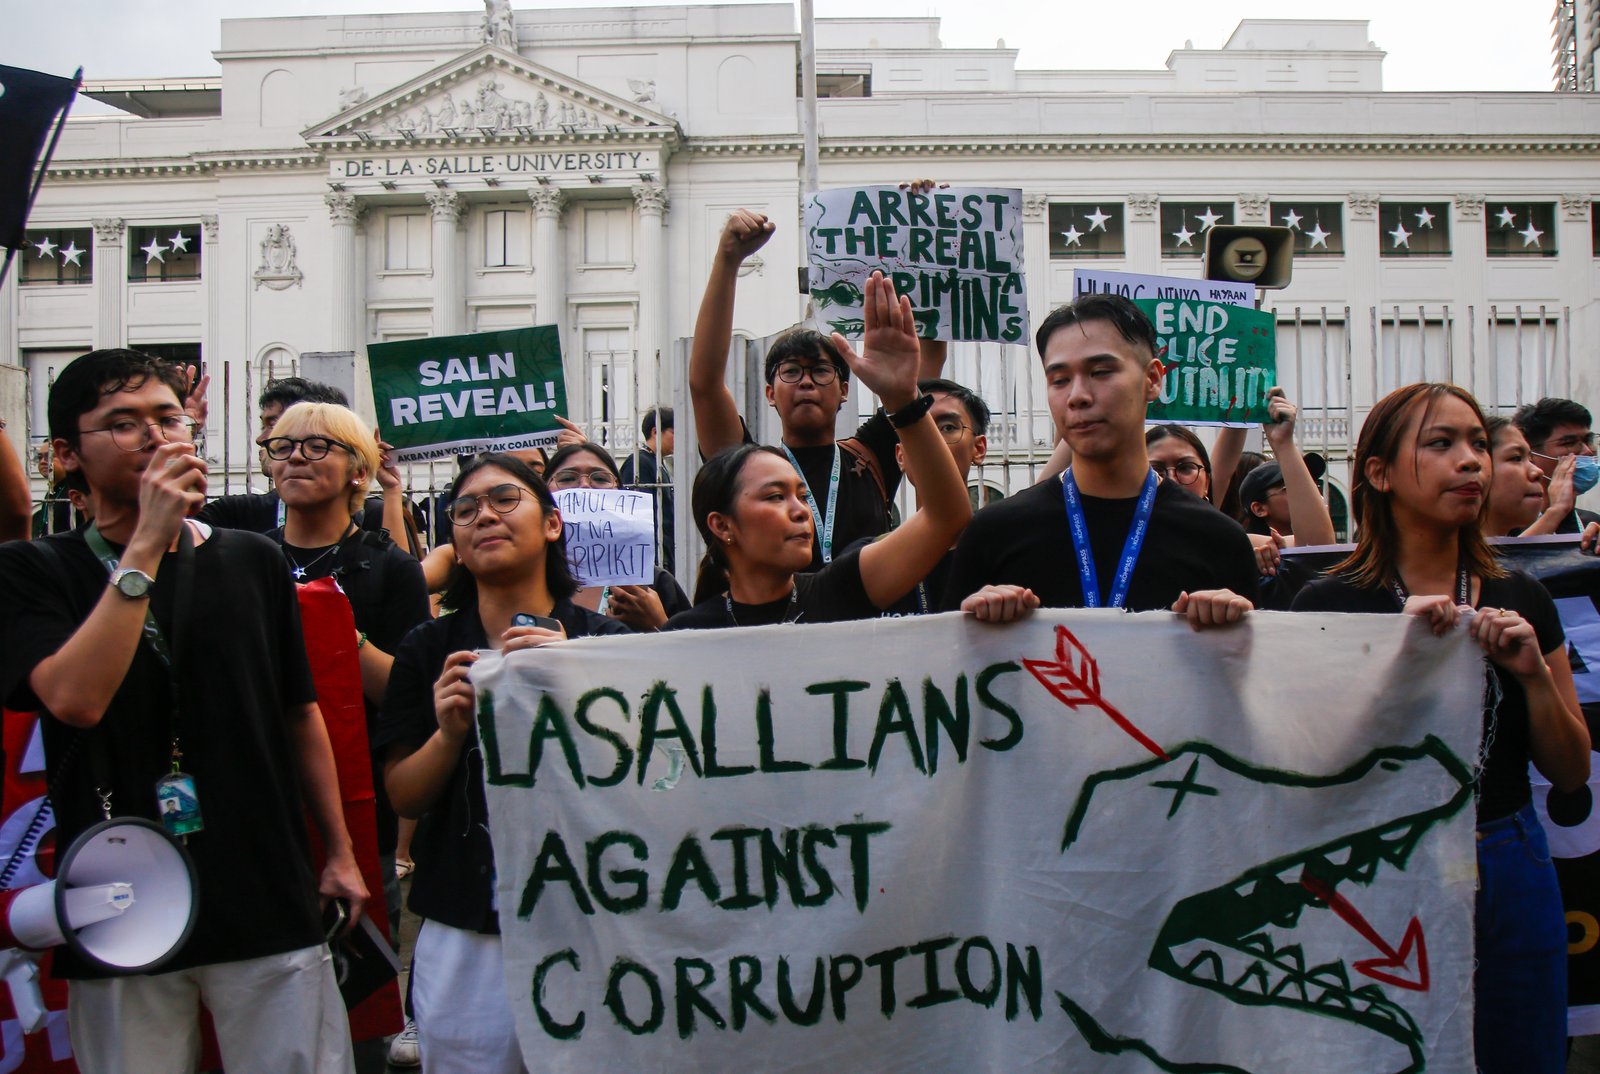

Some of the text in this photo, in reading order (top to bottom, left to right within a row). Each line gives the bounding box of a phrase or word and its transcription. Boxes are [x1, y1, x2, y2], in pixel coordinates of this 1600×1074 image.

[345, 151, 642, 177] DE LA SALLE UNIVERSITY
[848, 190, 1010, 231] ARREST
[817, 225, 1012, 274] THE REAL
[1209, 289, 1247, 300] HAYAAN
[1155, 301, 1229, 335] END
[419, 352, 516, 387] SALN
[391, 381, 558, 427] REVEAL!
[397, 449, 445, 463] AKBAYAN
[444, 444, 477, 456] YOUTH
[485, 443, 506, 452] YAK
[508, 436, 558, 450] COALITION
[558, 491, 643, 515] AMULAT
[588, 520, 613, 540] NA
[476, 661, 1024, 790] LASALLIANS
[517, 814, 893, 921] AGAINST
[531, 934, 1043, 1041] CORRUPTION
